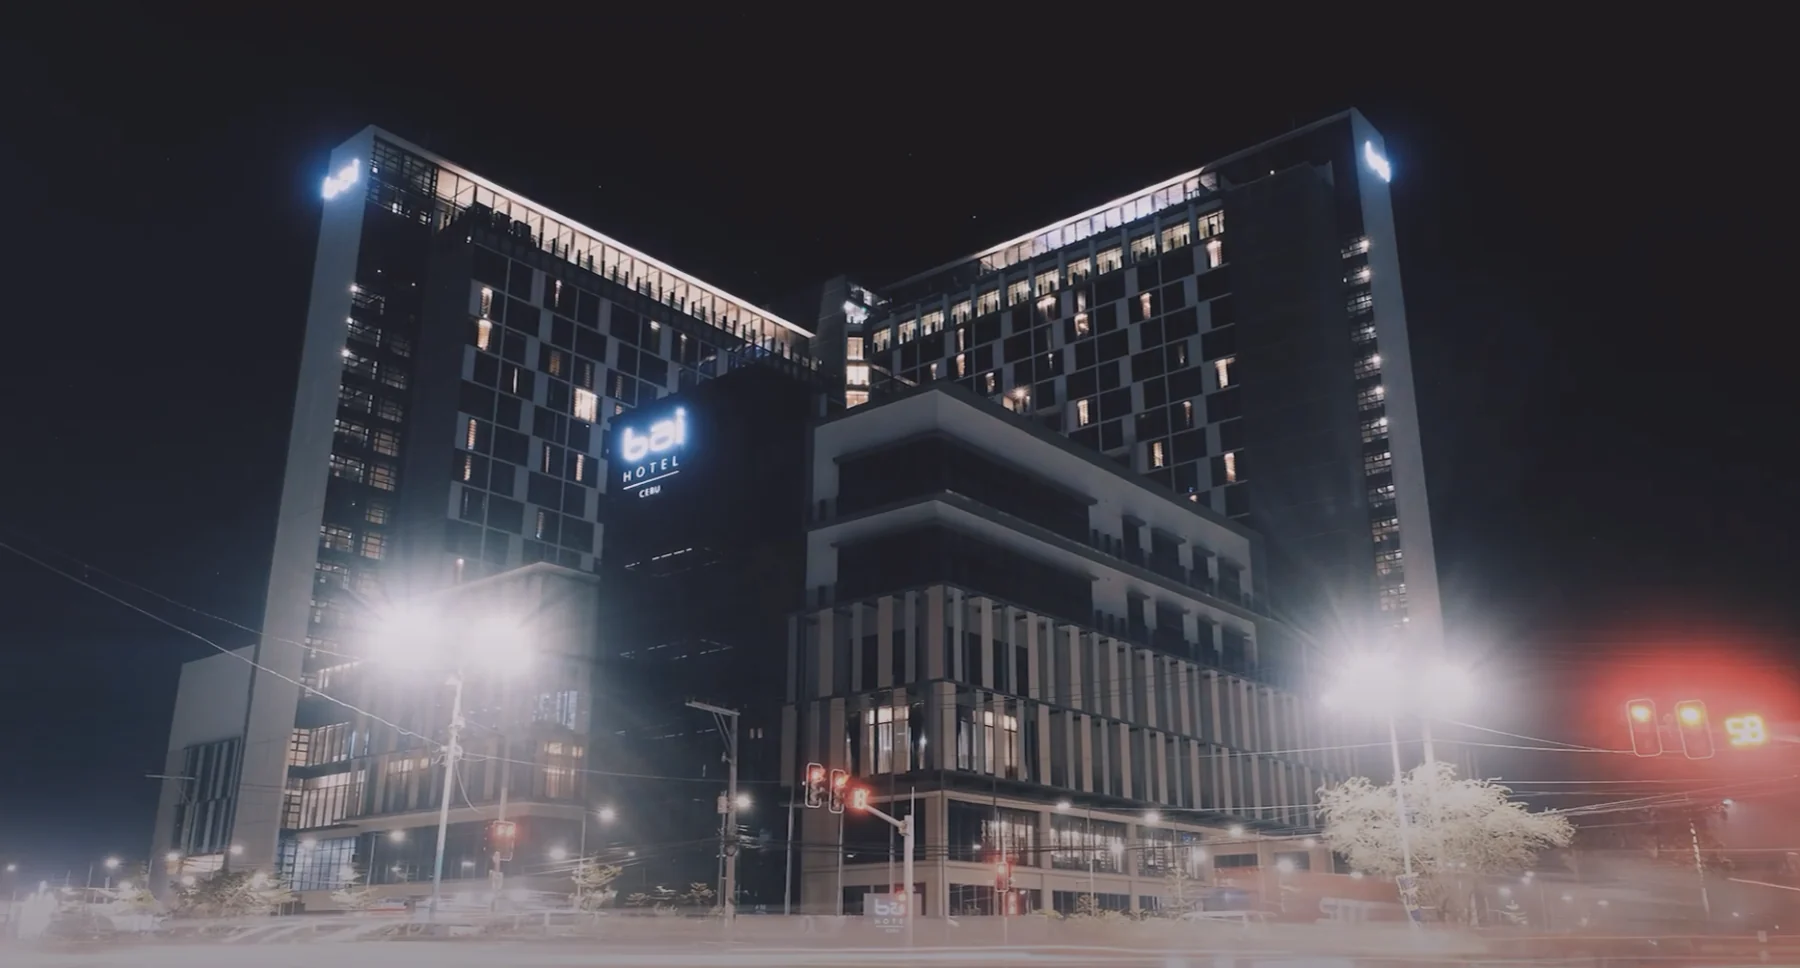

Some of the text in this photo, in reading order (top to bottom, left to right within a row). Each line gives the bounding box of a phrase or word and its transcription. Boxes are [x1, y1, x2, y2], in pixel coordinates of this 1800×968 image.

[622, 406, 686, 462] bai
[623, 455, 679, 483] HOTEL
[638, 484, 661, 498] CEBU
